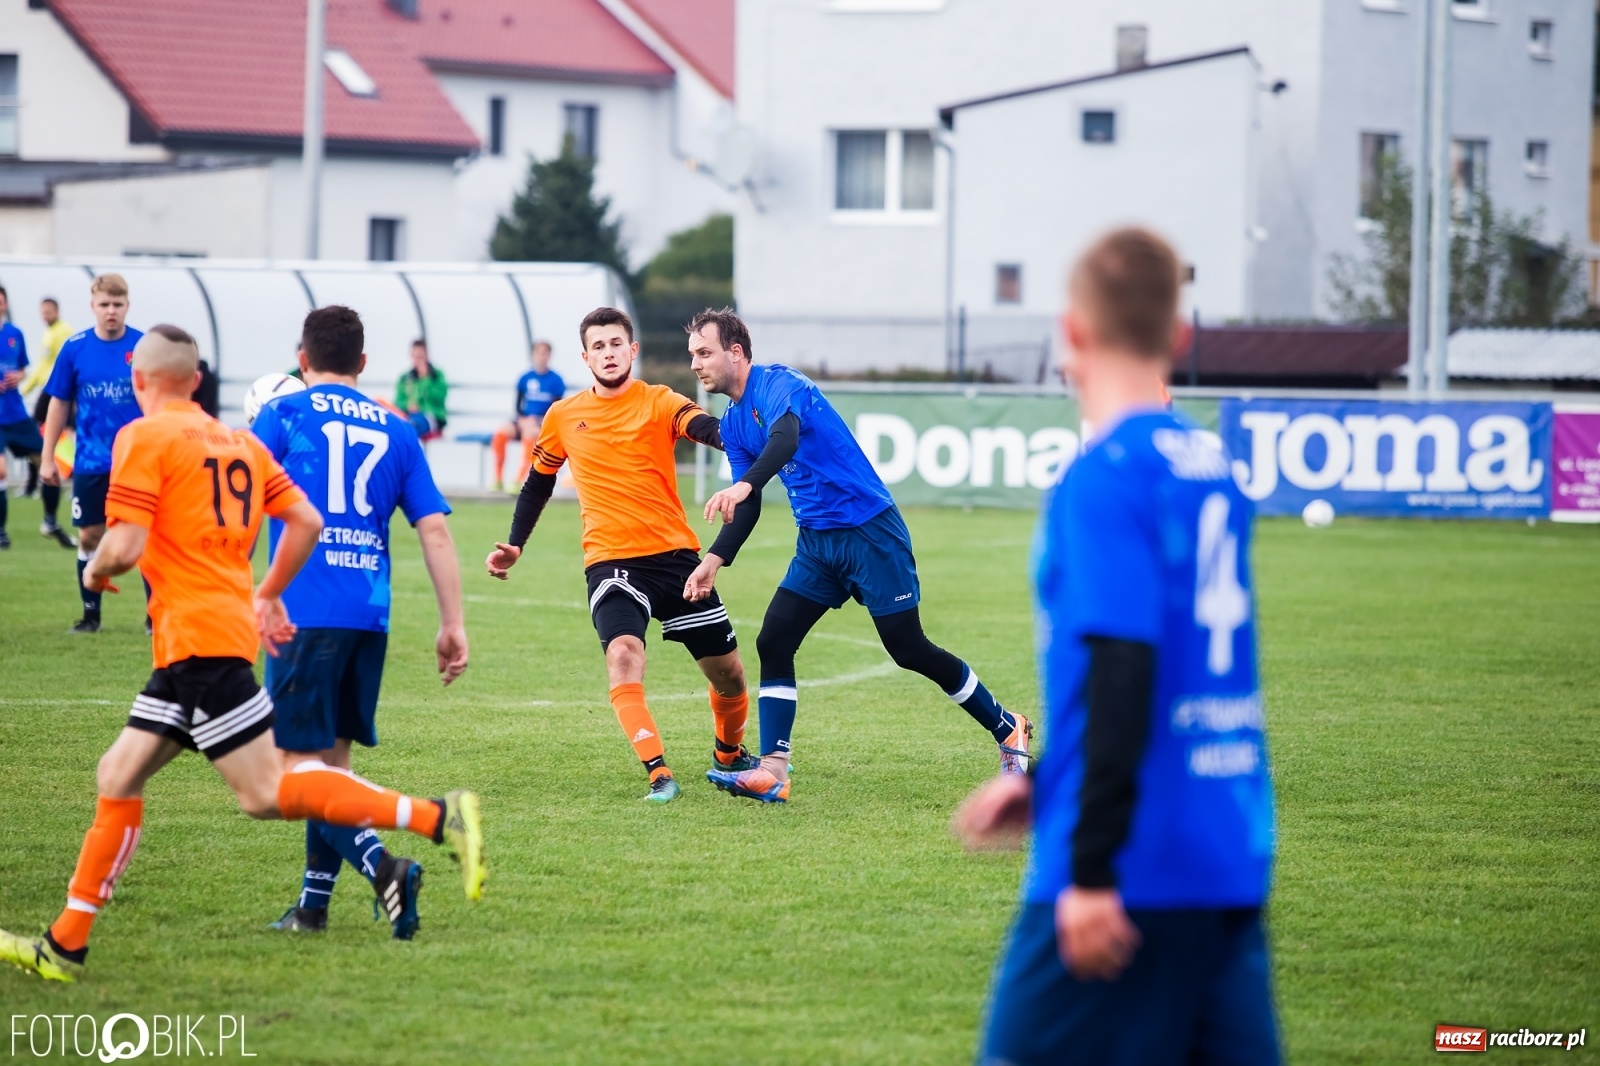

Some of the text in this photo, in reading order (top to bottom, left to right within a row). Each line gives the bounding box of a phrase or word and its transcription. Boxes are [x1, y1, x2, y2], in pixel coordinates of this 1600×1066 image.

[310, 392, 389, 426] START
[203, 457, 253, 528] 19
[321, 420, 389, 517] 17
[325, 549, 379, 571] WIELKIE
[1193, 491, 1250, 677] 4
